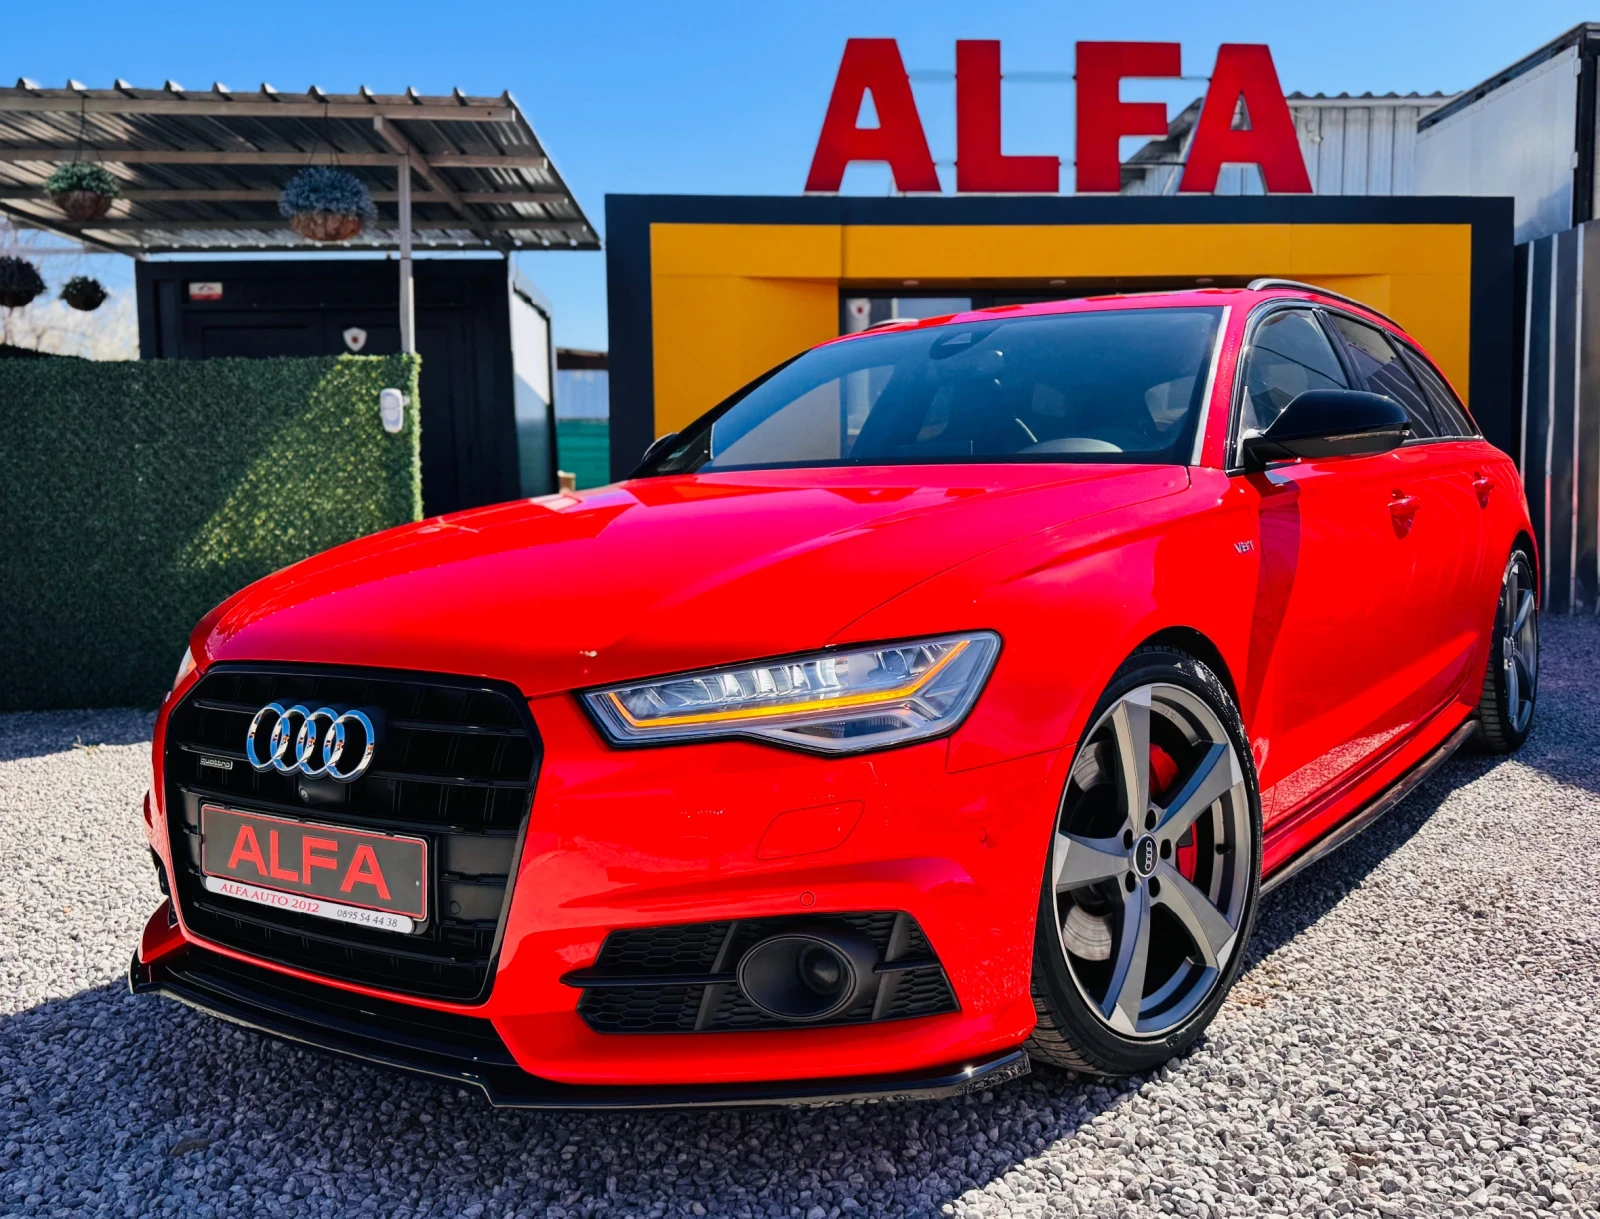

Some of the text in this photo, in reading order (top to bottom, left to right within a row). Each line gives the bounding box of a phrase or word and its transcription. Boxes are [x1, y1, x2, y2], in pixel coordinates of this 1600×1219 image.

[804, 38, 1313, 192] ALFA
[227, 824, 392, 900] ALFA
[220, 883, 319, 913] ALFA AUTO 2012
[337, 909, 398, 928] 0895 54 44 38
